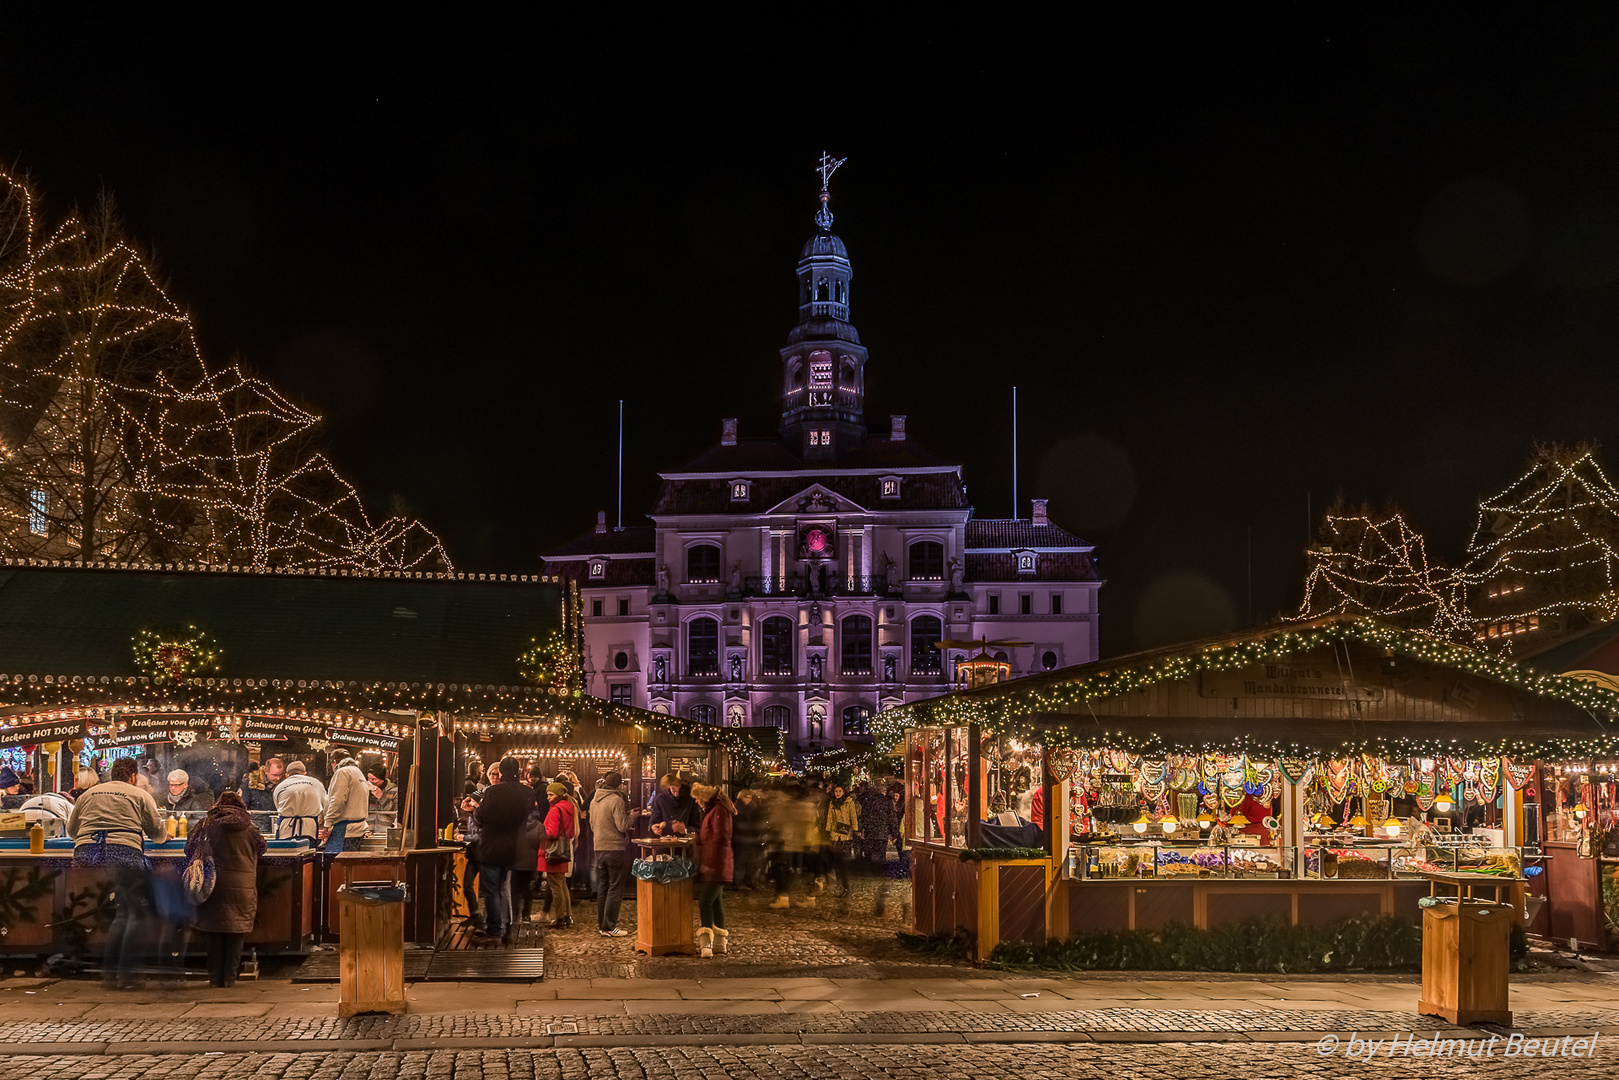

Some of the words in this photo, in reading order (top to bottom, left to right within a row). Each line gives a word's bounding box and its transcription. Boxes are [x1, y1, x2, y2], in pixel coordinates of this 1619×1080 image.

[131, 719, 168, 727] Krakauer
[188, 718, 209, 727] Grill
[245, 720, 283, 731] Bratwurst
[285, 724, 301, 732] vom
[302, 725, 323, 734] Grill
[1, 732, 31, 744] Leckere
[33, 727, 51, 738] HOT
[54, 725, 80, 736] DOGS
[148, 731, 167, 740] Grill
[244, 731, 277, 739] Krakauer
[332, 732, 365, 743] Bratwurst
[365, 738, 380, 746] vom
[380, 740, 398, 748] Grill
